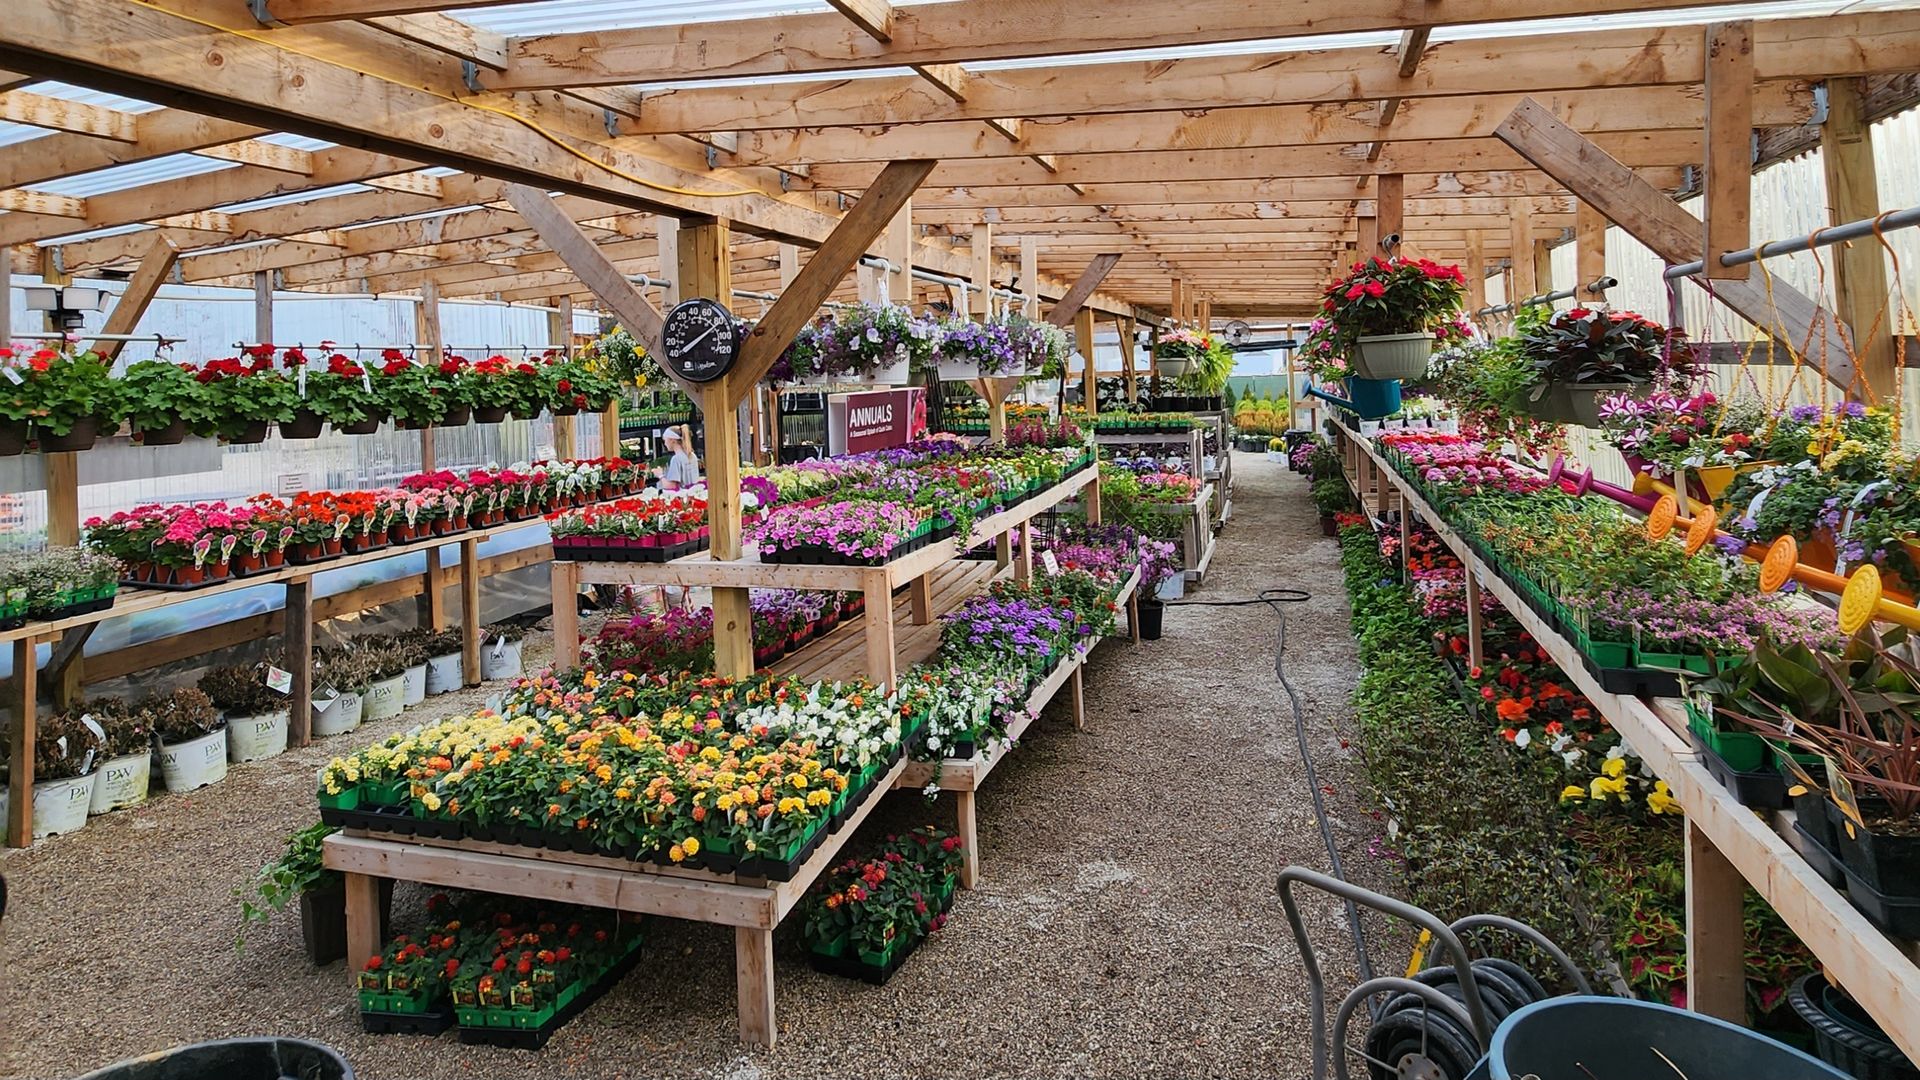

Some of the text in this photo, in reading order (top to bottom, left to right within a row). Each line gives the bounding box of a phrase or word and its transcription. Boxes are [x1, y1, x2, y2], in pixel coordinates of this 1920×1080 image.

[688, 306, 712, 316] 40 60
[677, 312, 687, 320] 20
[719, 331, 732, 340] 100
[666, 337, 676, 346] 20
[669, 349, 679, 358] 40
[719, 345, 731, 354] 120
[849, 404, 892, 428] ANNUALS
